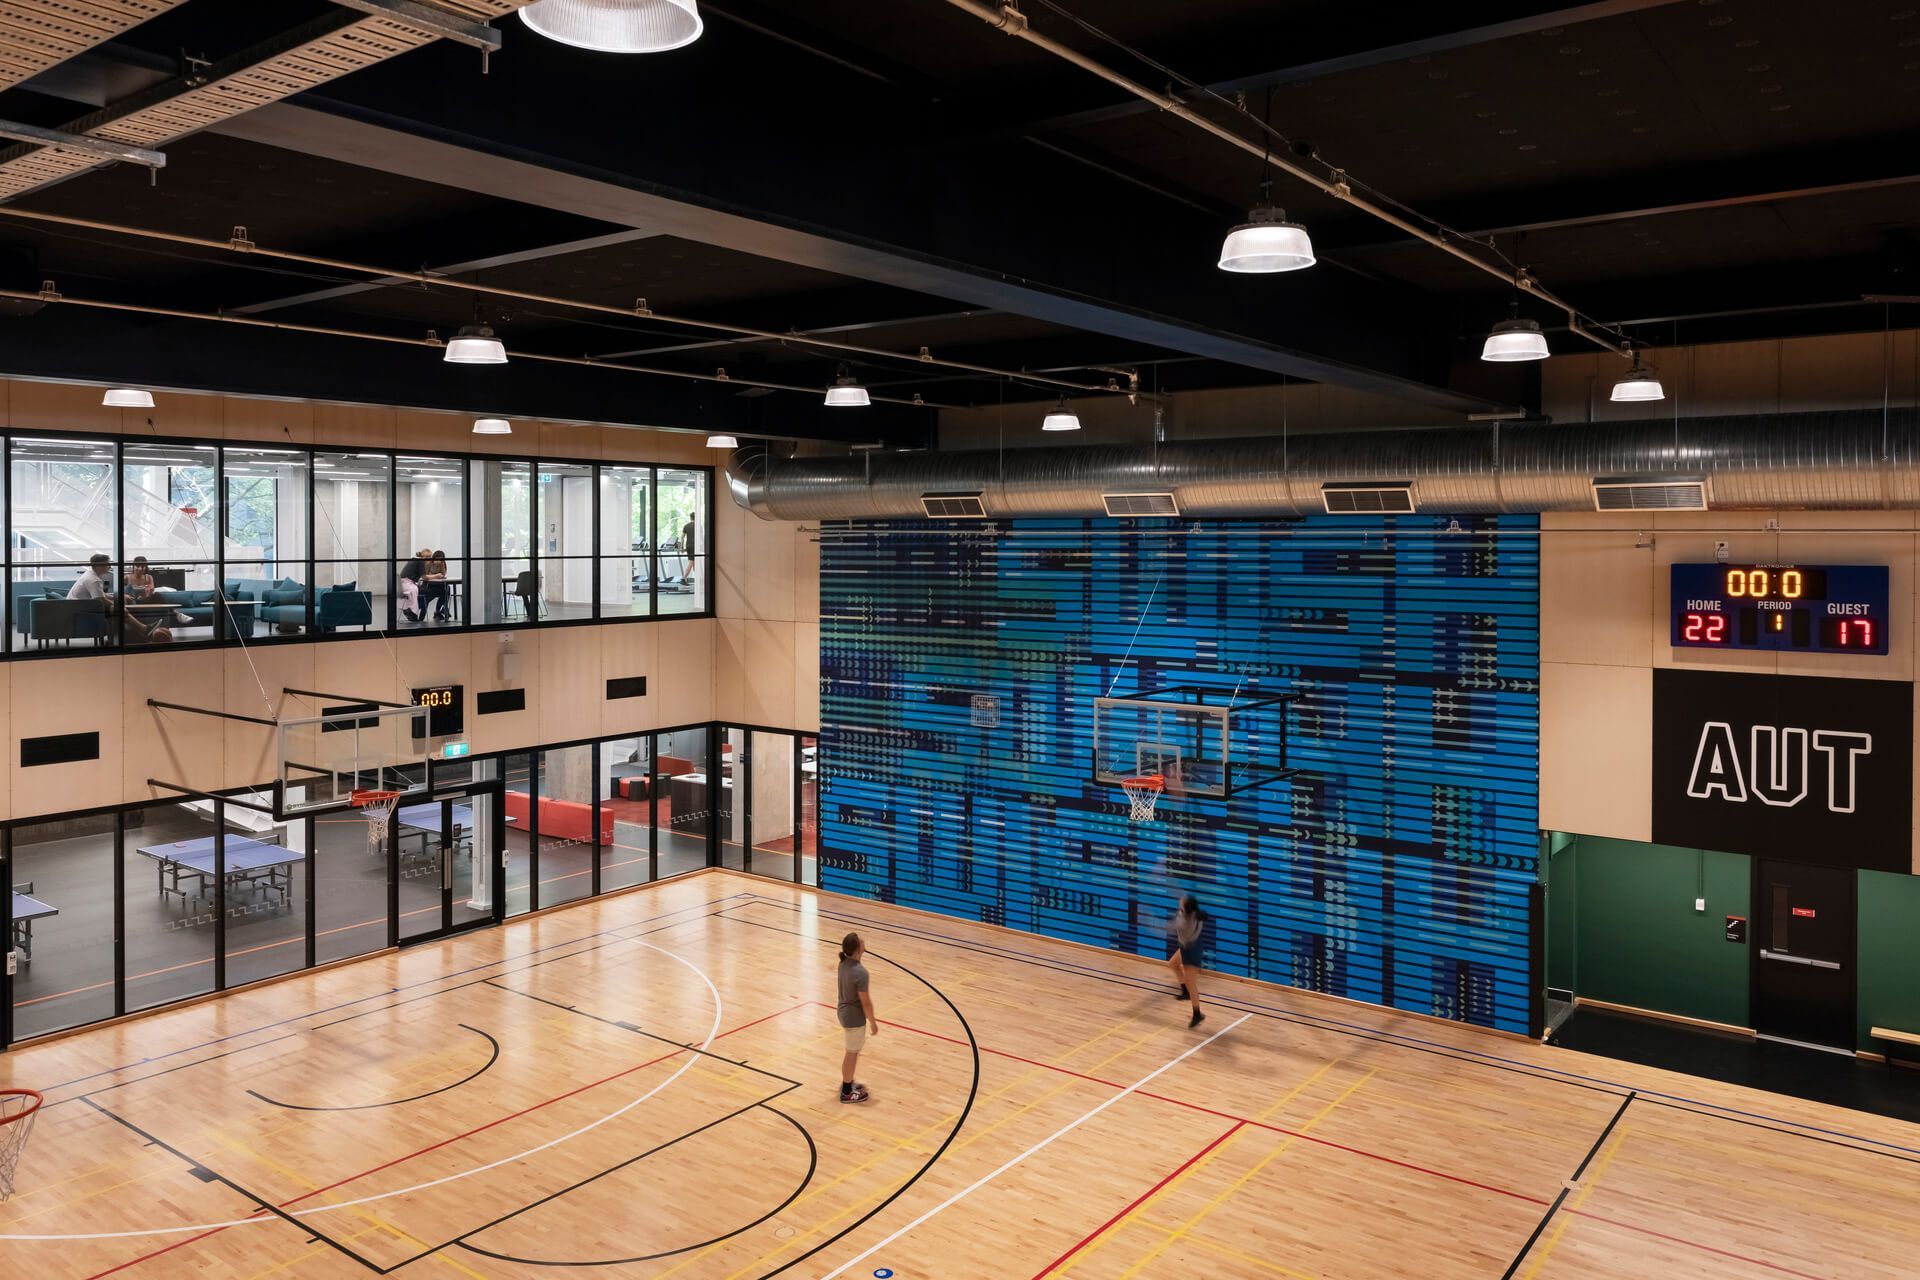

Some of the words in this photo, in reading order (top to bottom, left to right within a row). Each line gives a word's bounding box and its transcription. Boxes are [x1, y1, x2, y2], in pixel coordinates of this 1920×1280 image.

[1687, 599, 1722, 611] HOME
[1757, 600, 1792, 610] PERIOD
[1827, 603, 1870, 615] GUEST
[1685, 615, 1724, 642] 22
[1775, 614, 1783, 631] 1
[1840, 620, 1871, 646] 17
[421, 691, 452, 707] 00.0
[1687, 721, 1872, 814] AUT
